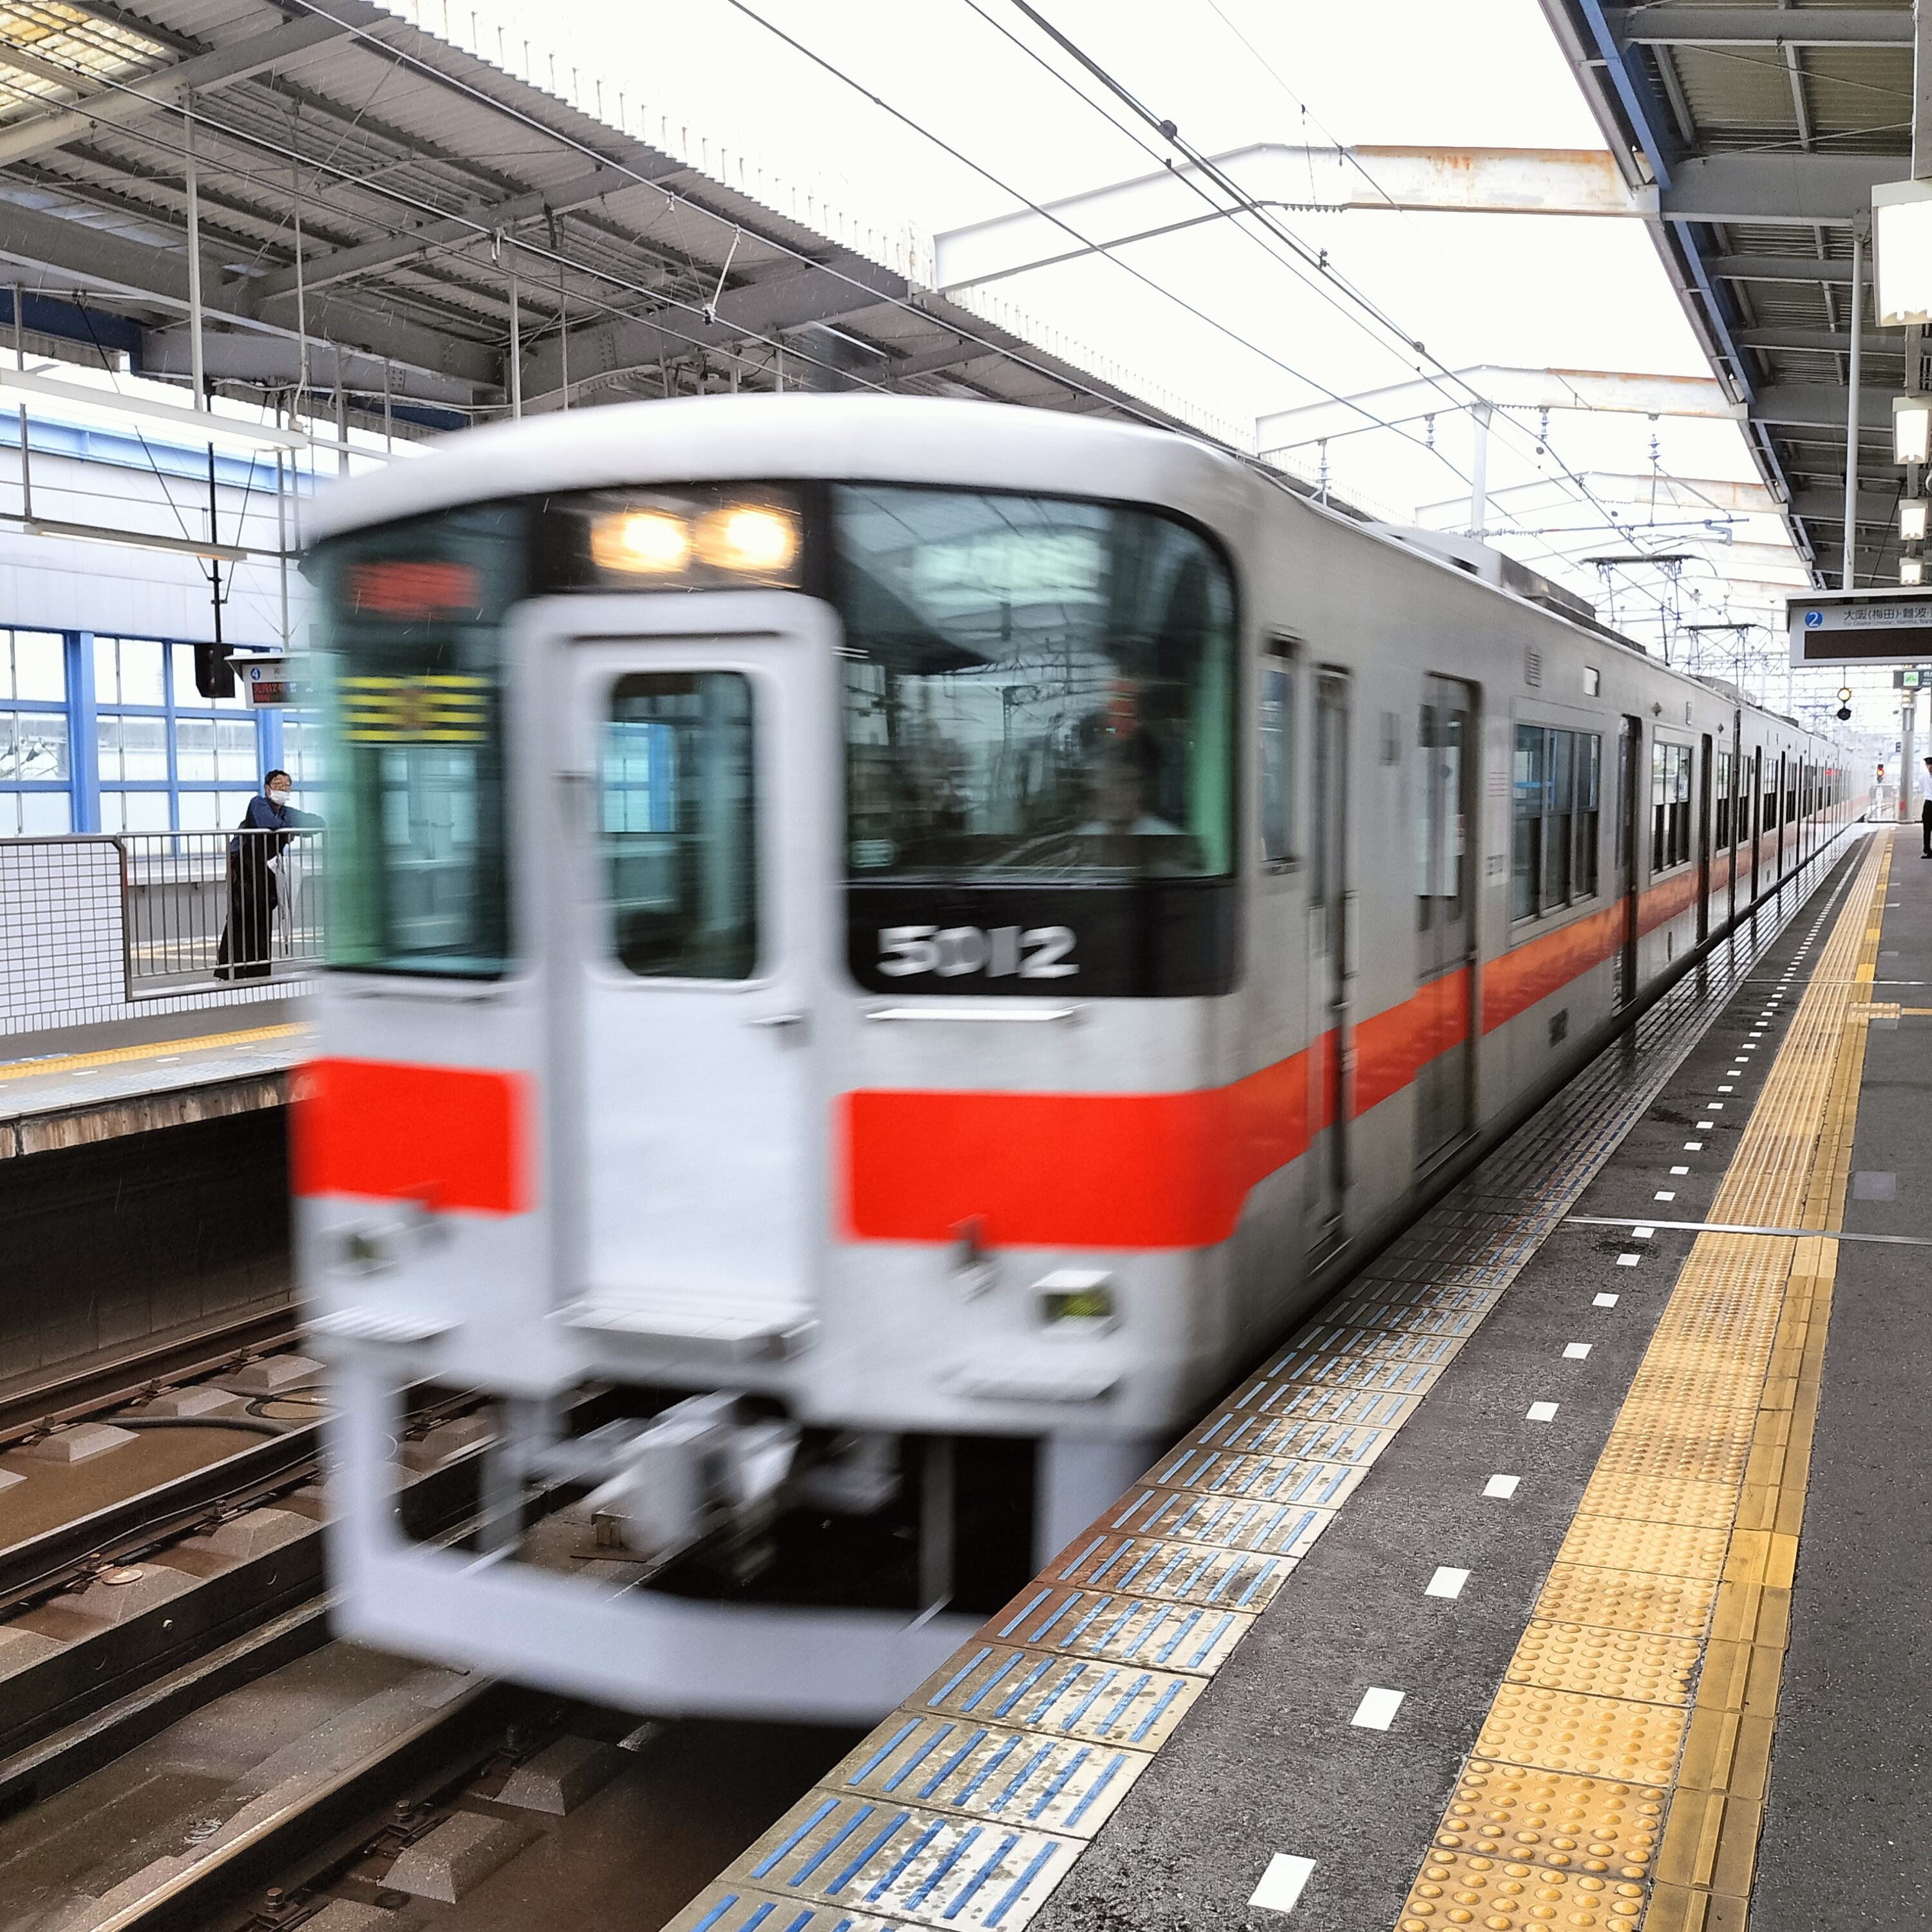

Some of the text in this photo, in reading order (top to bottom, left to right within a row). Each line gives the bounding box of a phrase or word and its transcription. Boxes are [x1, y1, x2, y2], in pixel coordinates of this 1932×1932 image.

[1808, 612, 1820, 627] 2
[252, 668, 259, 680] 4
[876, 925, 1080, 978] 5012
